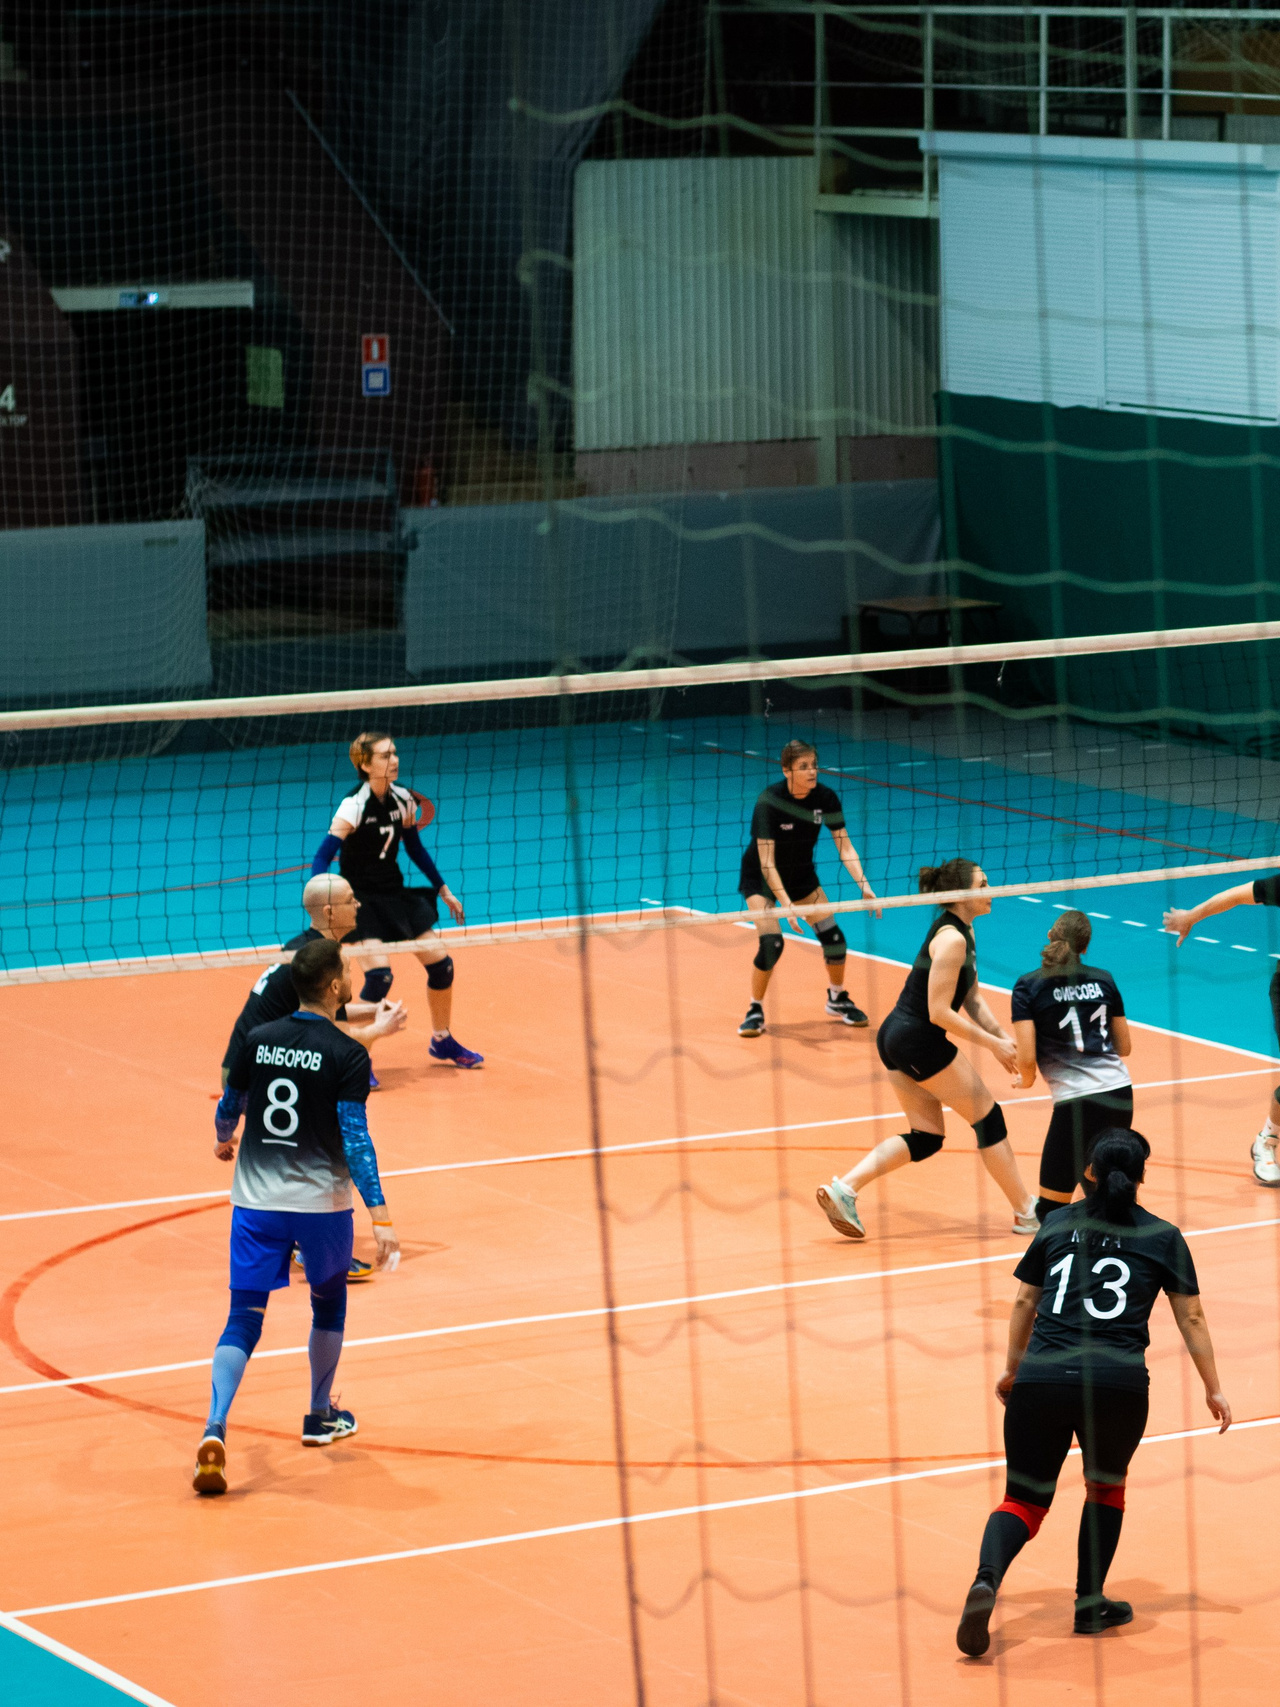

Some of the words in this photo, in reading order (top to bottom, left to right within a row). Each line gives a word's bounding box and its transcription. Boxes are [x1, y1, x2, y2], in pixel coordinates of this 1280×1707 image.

[379, 824, 395, 859] 7
[1053, 982, 1104, 1002] ФИРСОВА
[1058, 1004, 1112, 1052] 11
[256, 1044, 322, 1071] ВЫБОРОВ
[263, 1078, 299, 1137] 8
[1050, 1253, 1131, 1319] 13
